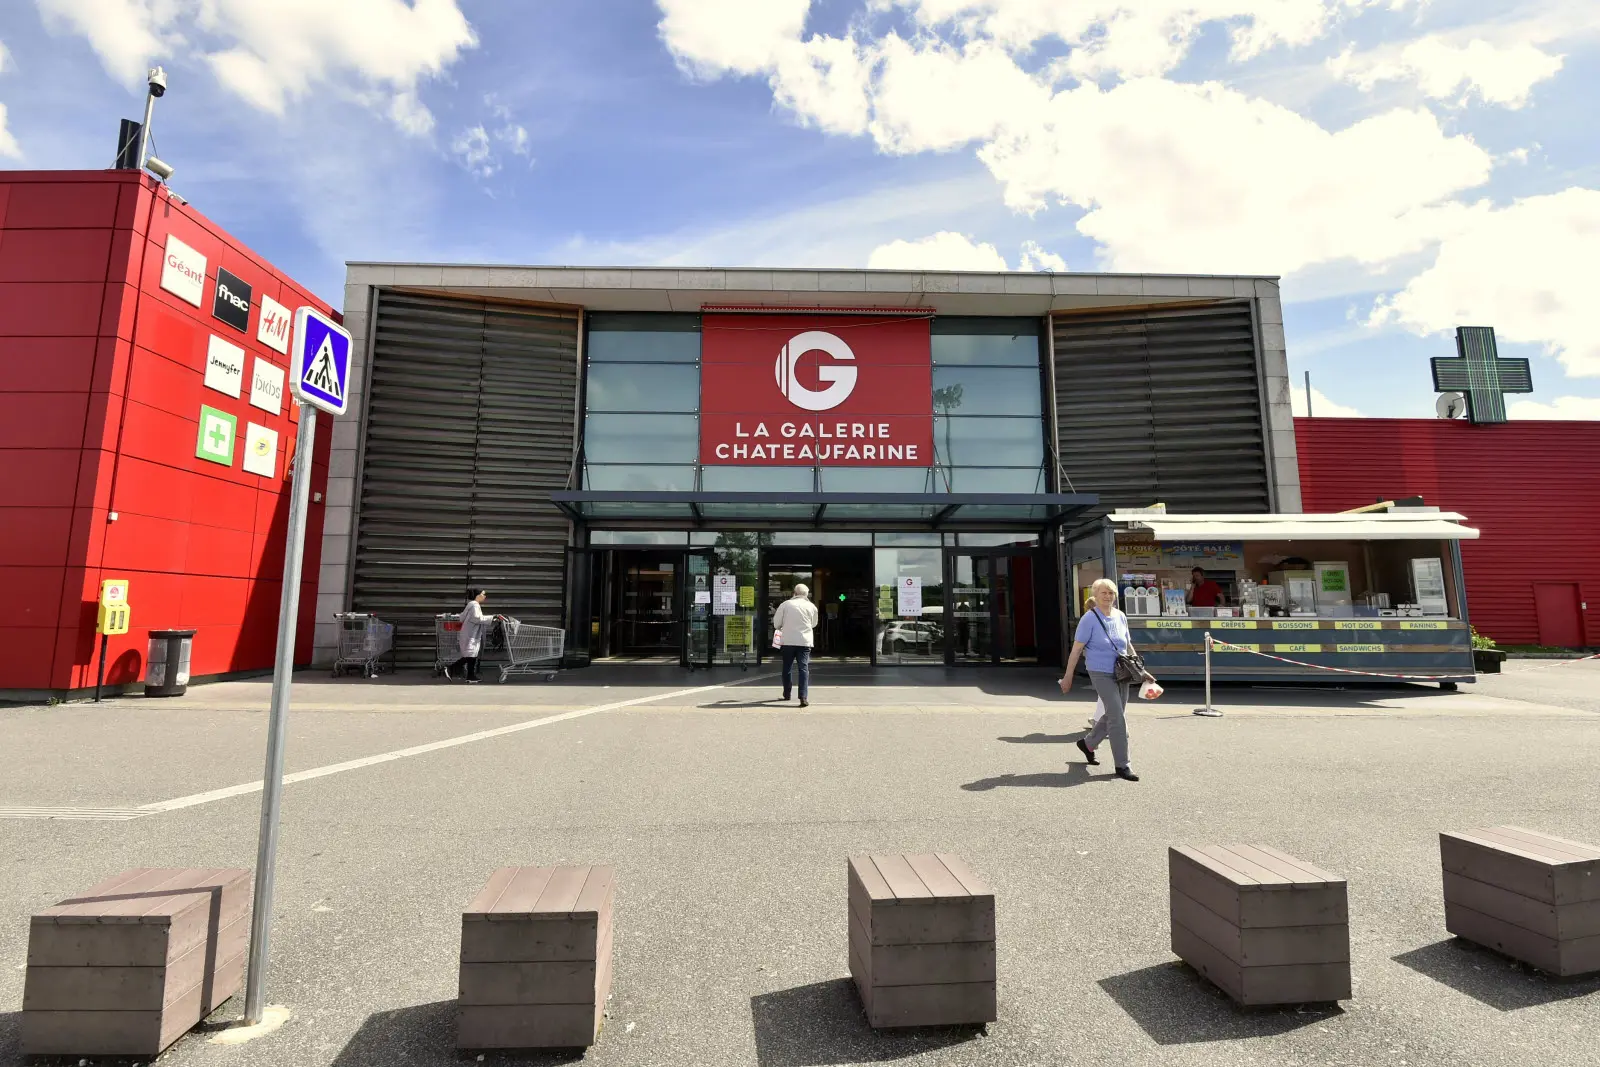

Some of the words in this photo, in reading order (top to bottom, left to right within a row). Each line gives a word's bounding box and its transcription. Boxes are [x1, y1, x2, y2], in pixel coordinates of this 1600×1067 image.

[167, 254, 203, 285] Géant
[219, 284, 249, 312] fnac
[210, 355, 240, 376] Jennyfer
[775, 330, 858, 411] G
[735, 422, 770, 438] LA
[780, 422, 890, 438] GALERIE
[715, 443, 918, 460] CHATEAUFARINE
